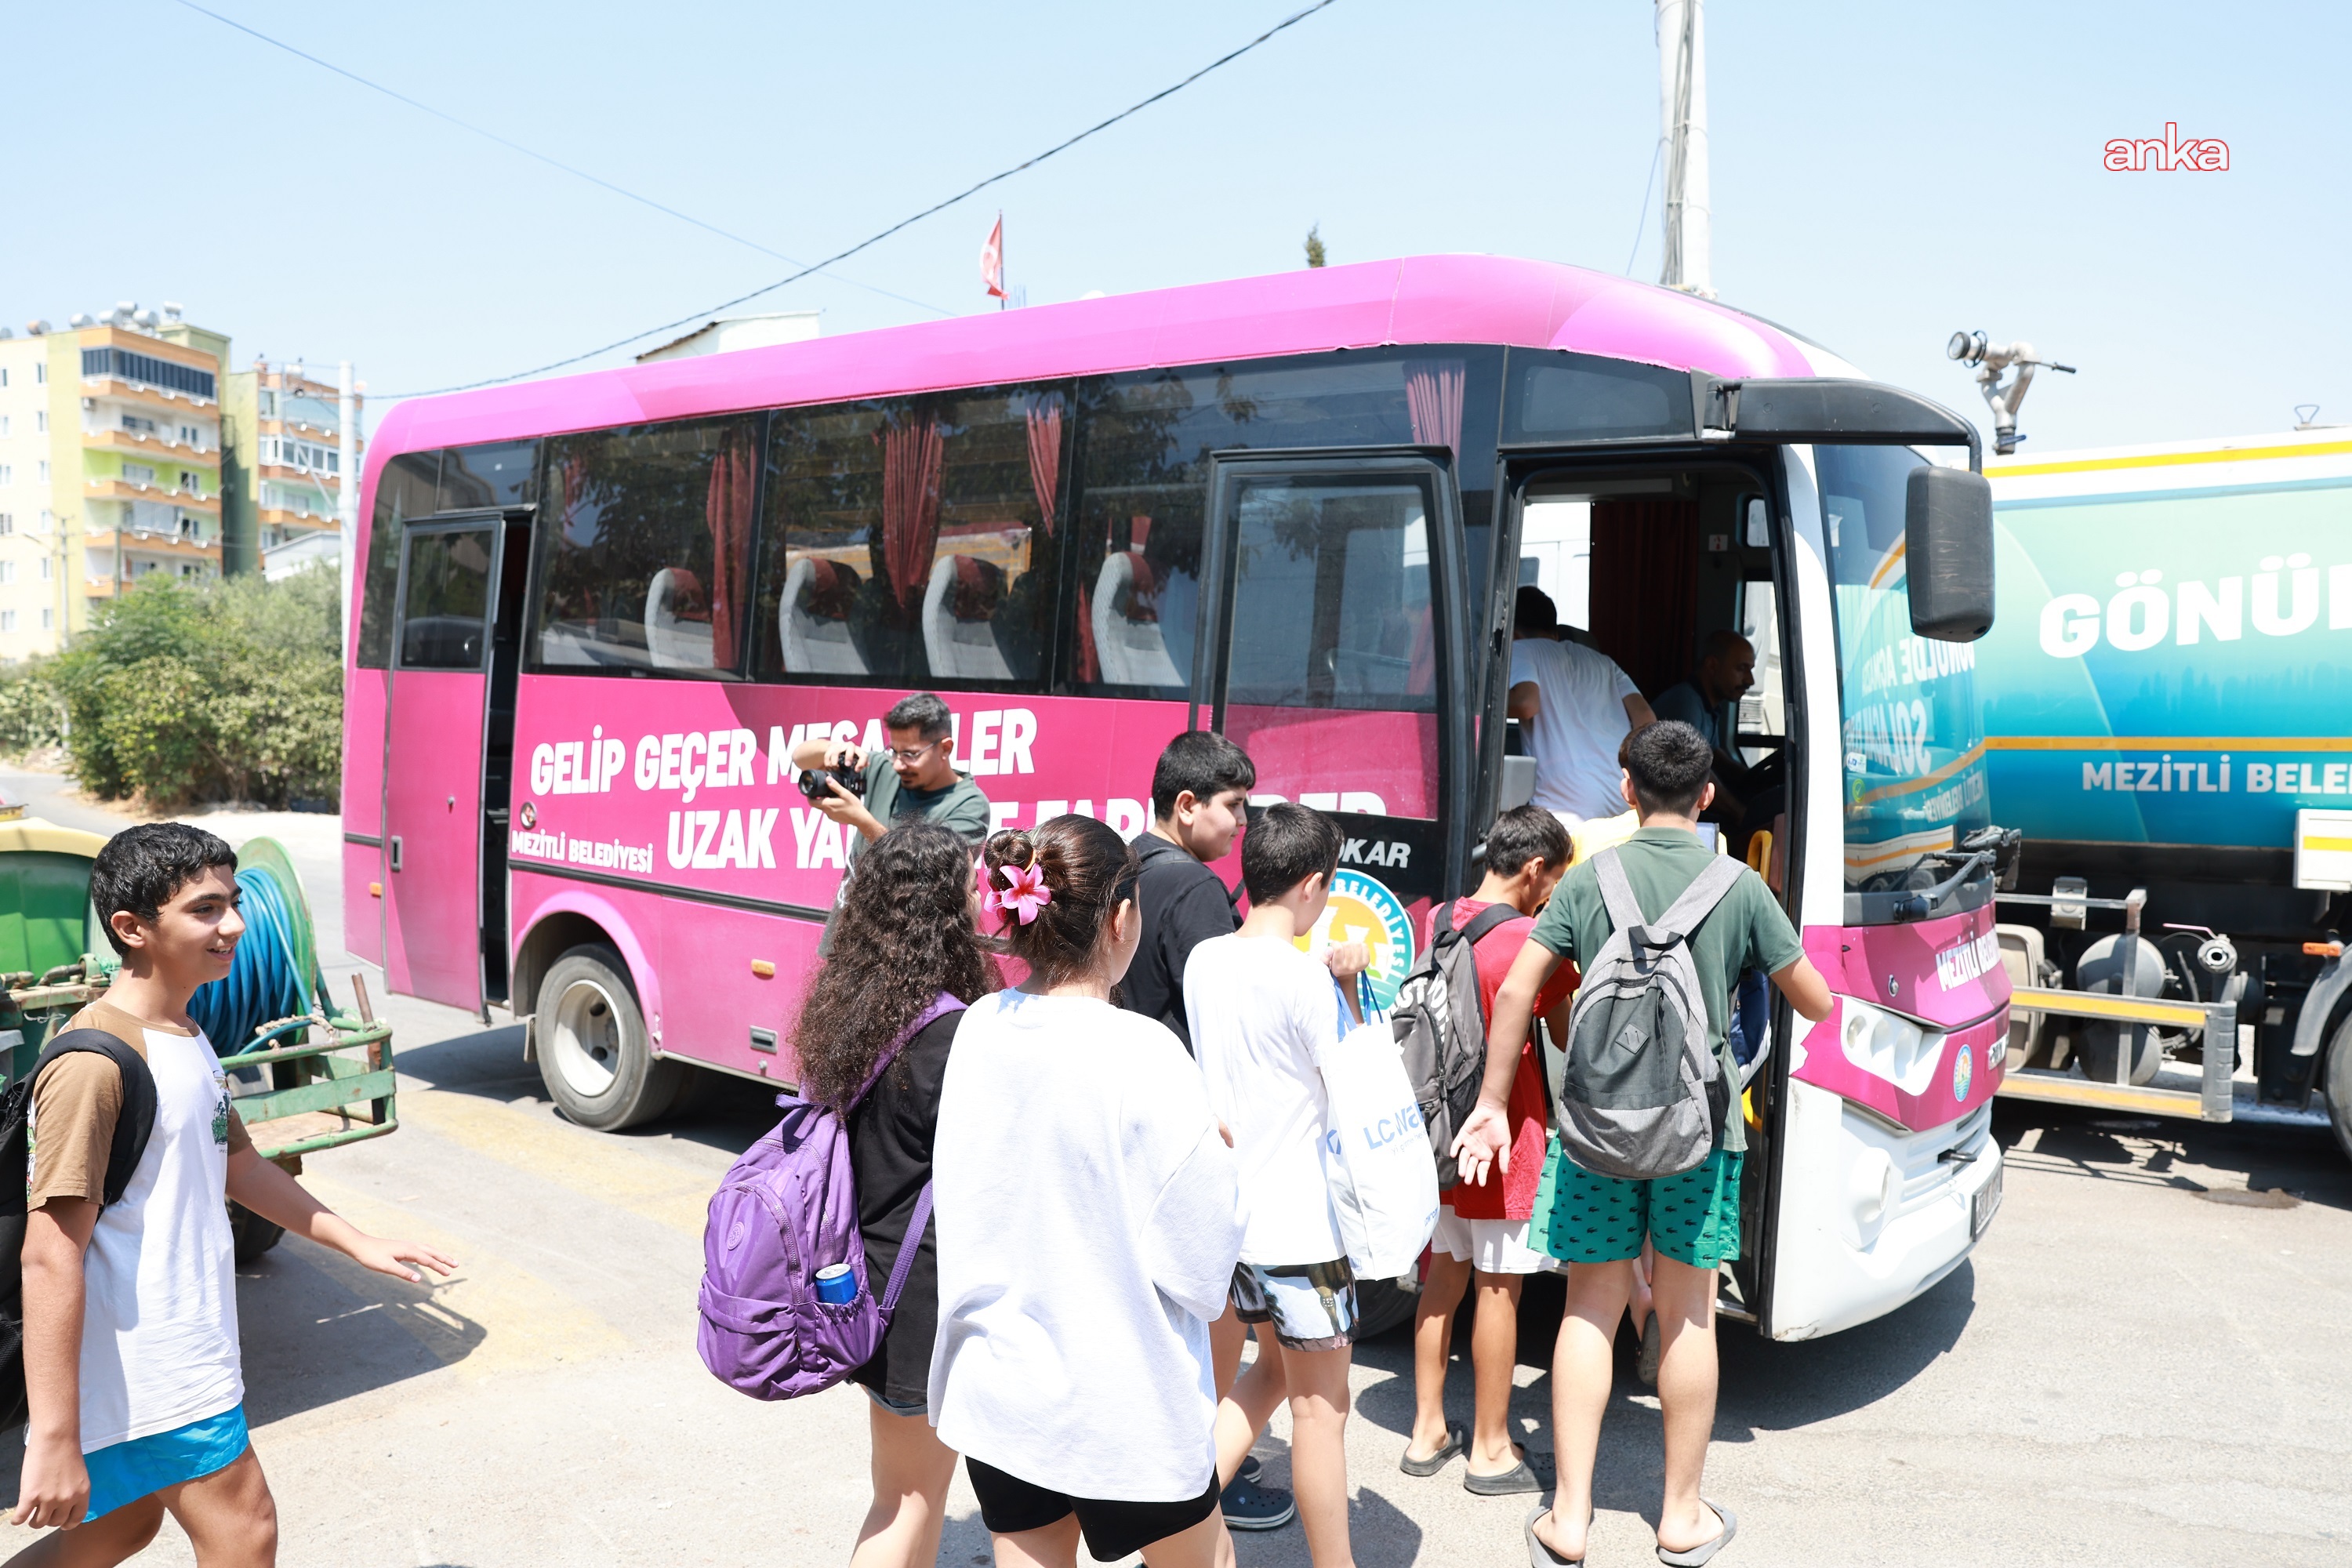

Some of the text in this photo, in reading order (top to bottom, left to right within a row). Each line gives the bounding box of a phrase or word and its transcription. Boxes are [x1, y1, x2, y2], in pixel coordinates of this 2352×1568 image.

[530, 724, 626, 797] GELİP
[633, 728, 757, 804] GEÇER
[2082, 753, 2352, 796] MEZİTLİ BELE
[511, 828, 654, 874] MEZİTLİ BELEDİYESİ
[667, 808, 780, 869] UZAK
[1334, 877, 1406, 981] BELEDİYESİ
